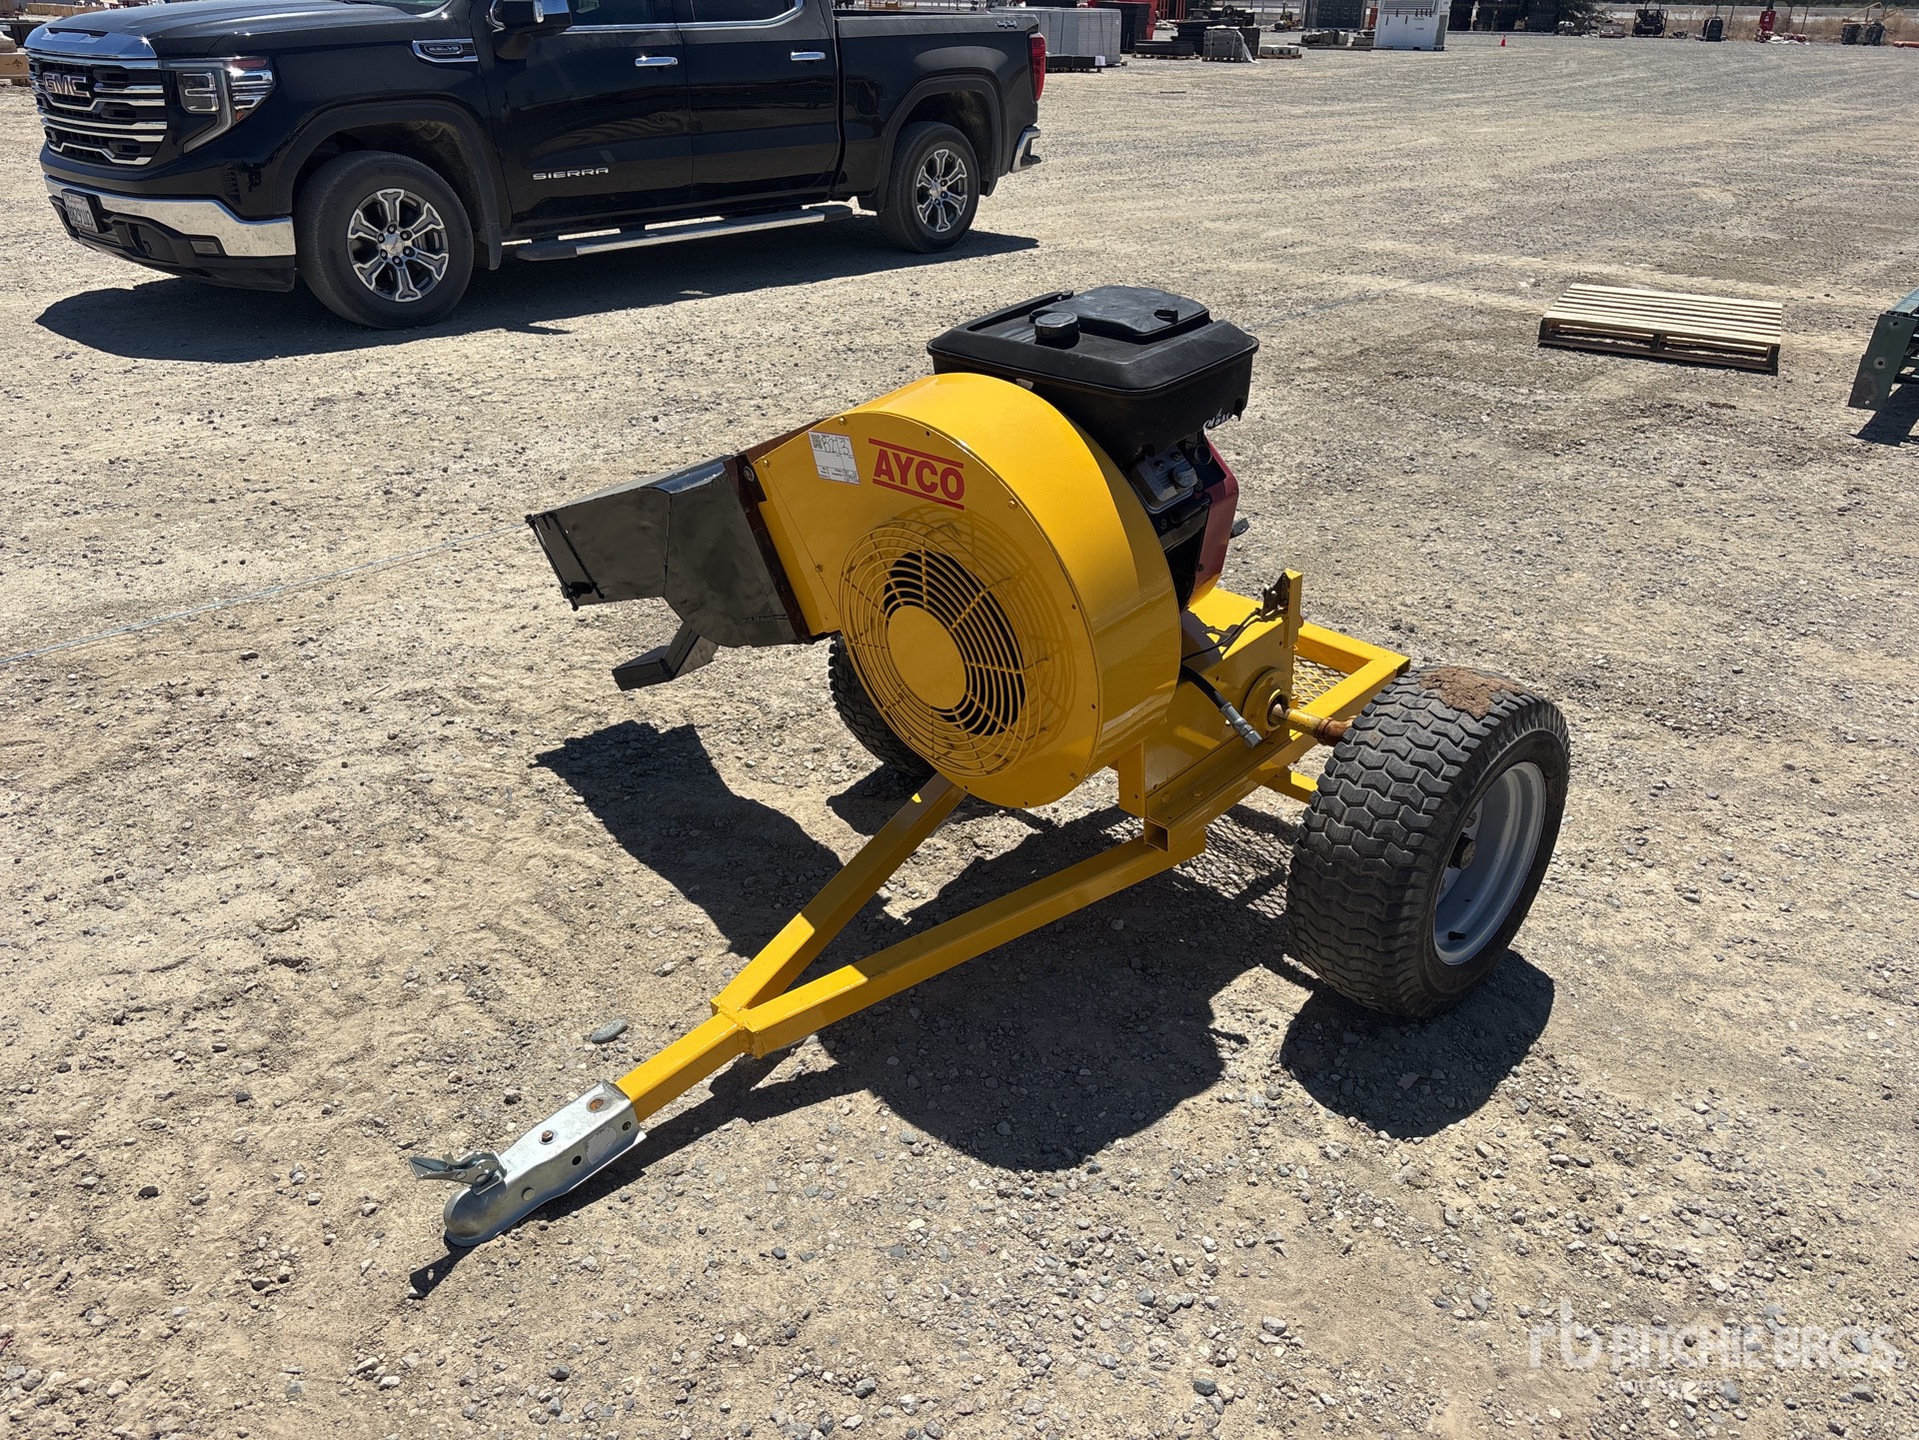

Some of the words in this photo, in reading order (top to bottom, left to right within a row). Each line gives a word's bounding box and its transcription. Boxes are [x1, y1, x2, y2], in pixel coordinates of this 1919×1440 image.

[43, 72, 91, 98] GMC
[532, 167, 609, 181] SIERRA
[873, 449, 965, 501] AYCO
